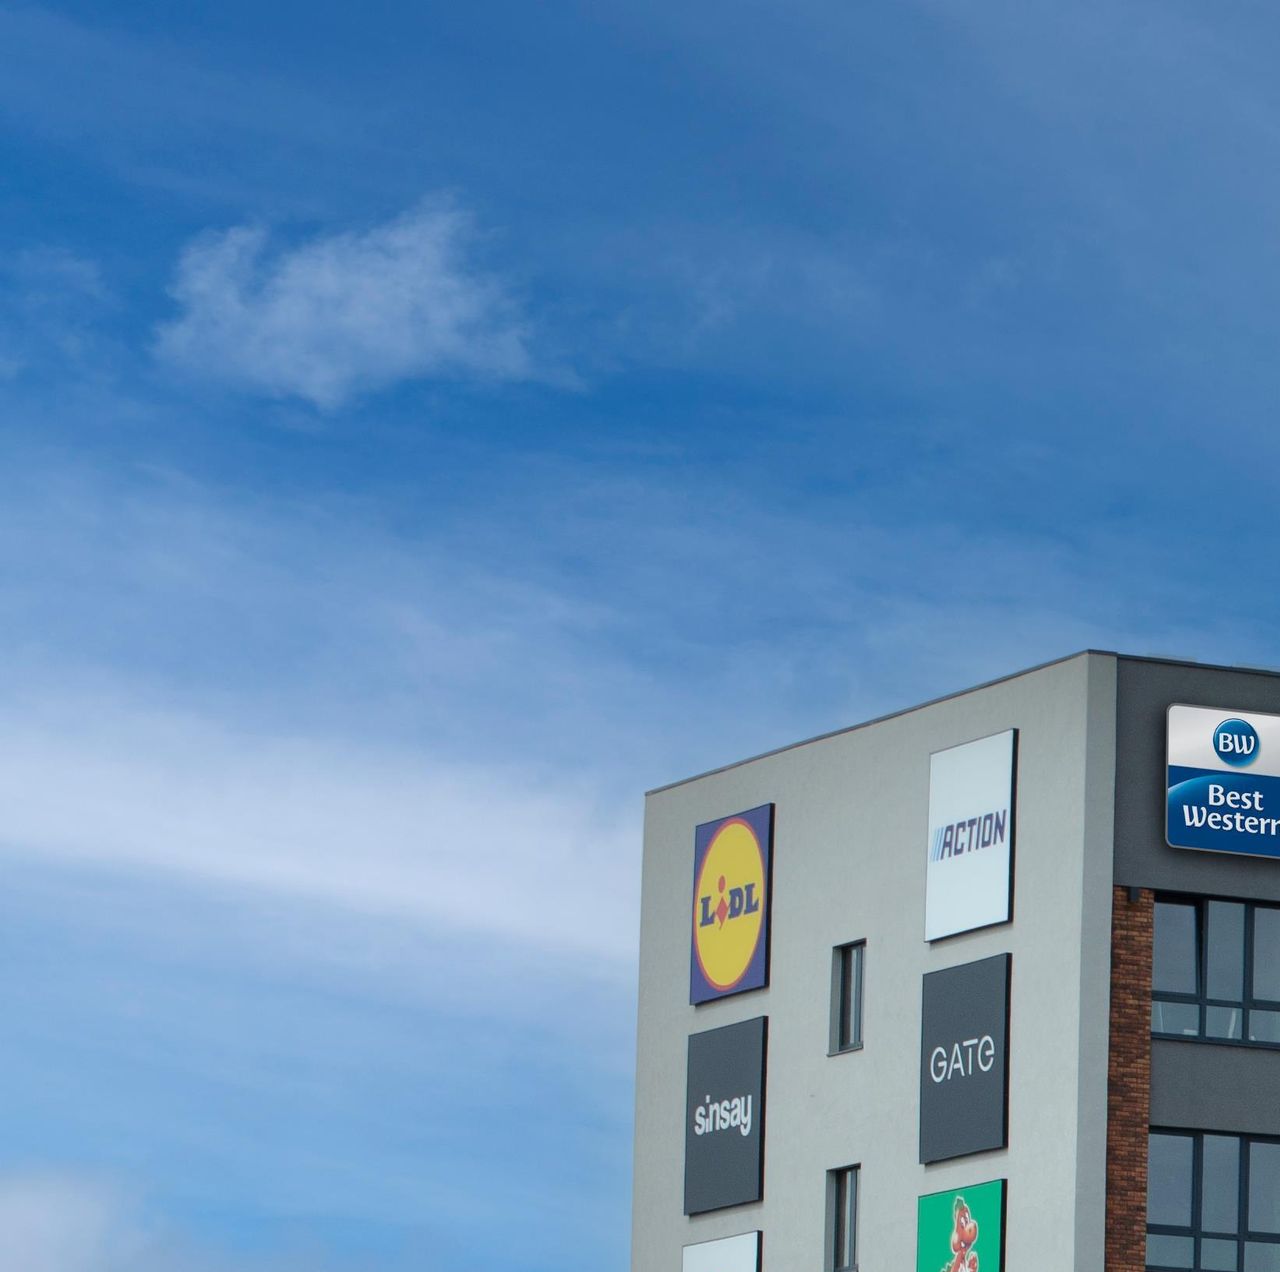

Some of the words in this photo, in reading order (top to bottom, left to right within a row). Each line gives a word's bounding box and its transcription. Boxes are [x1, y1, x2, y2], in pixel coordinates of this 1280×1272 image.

[1218, 732, 1255, 755] BW
[1208, 784, 1265, 811] Best
[940, 809, 1007, 861] ACTION
[694, 1094, 752, 1136] sinsay
